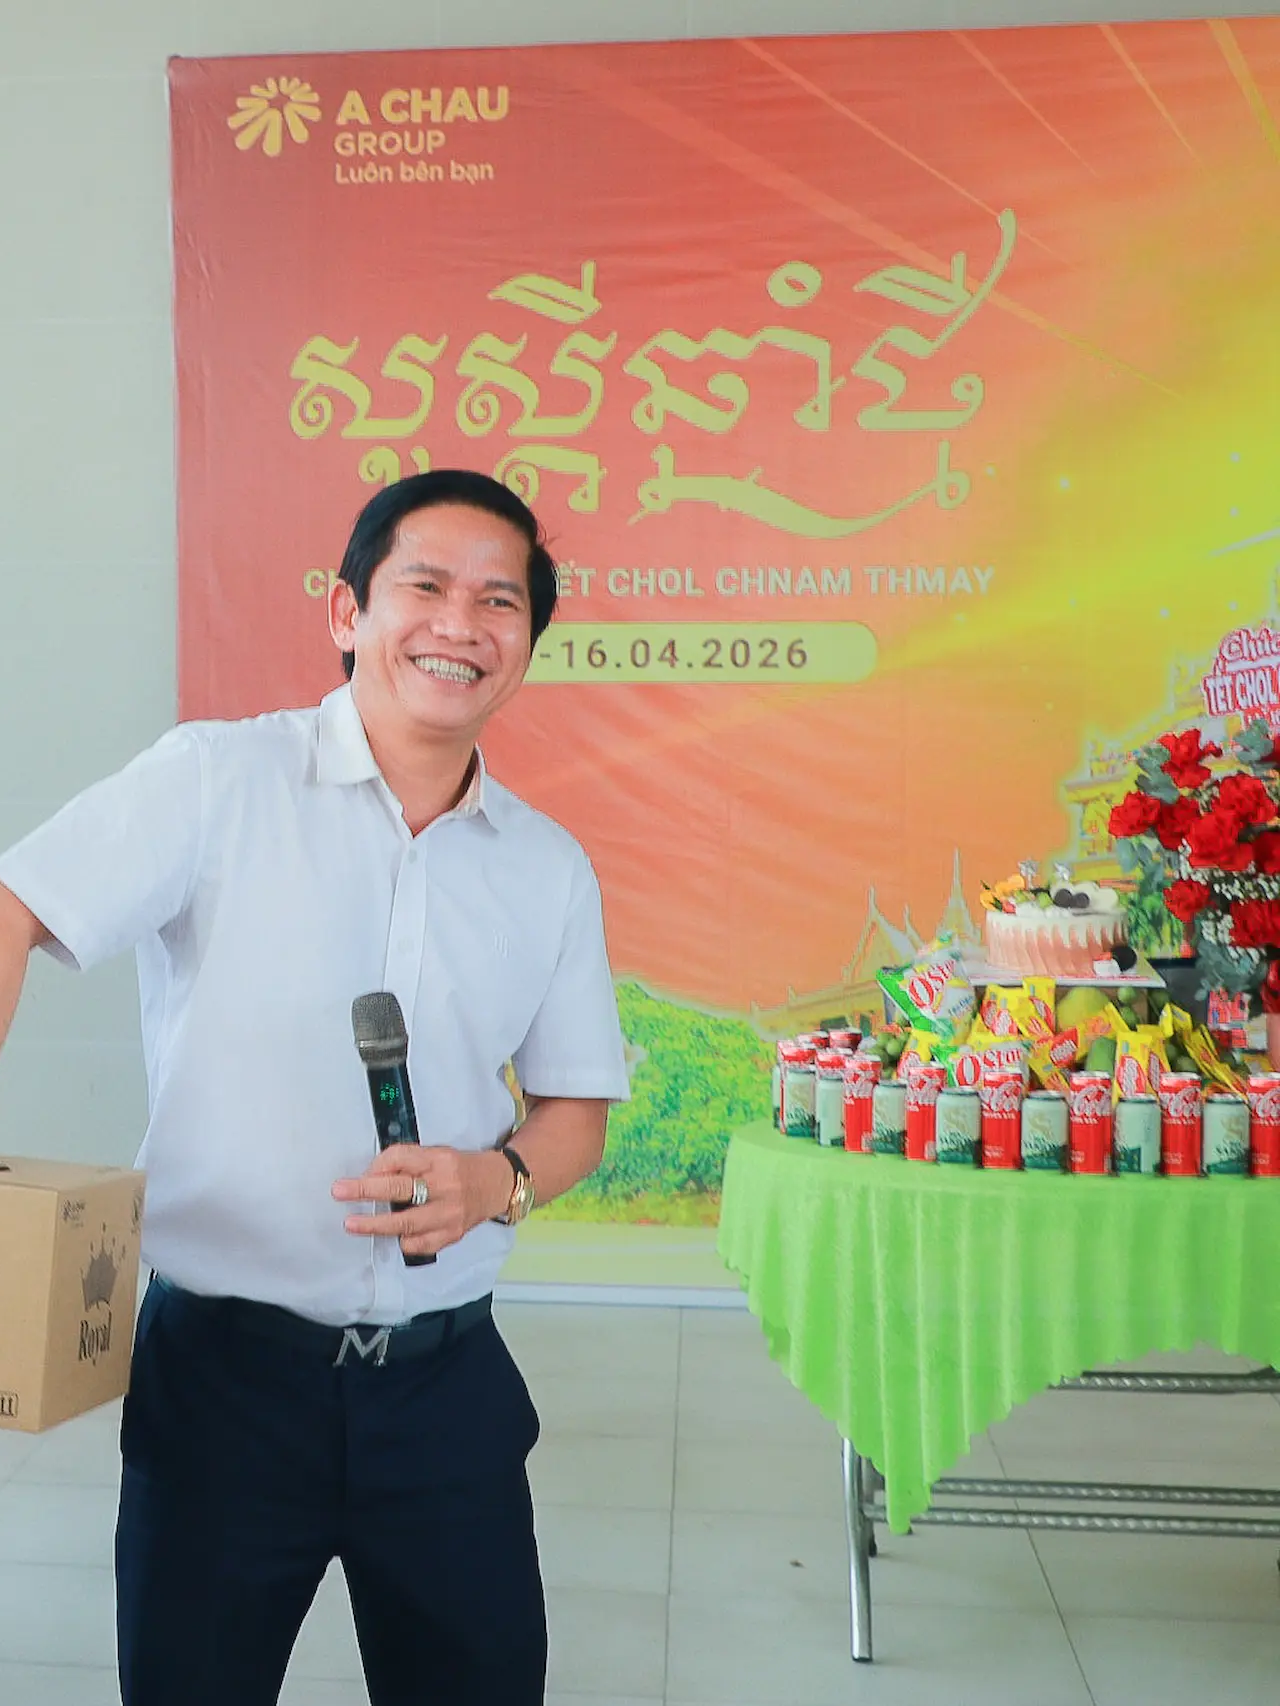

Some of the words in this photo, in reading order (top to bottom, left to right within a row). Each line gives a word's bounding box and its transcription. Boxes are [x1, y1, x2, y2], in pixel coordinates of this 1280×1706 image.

[336, 91, 370, 125] A
[380, 86, 510, 124] CHAU
[334, 130, 447, 157] GROUP
[335, 162, 393, 184] Luôn
[399, 162, 443, 183] bên
[450, 161, 494, 185] bạn
[608, 568, 703, 598] CHOL
[715, 566, 854, 598] CHNAM
[864, 564, 995, 597] THMAY
[78, 1310, 113, 1366] Royal
